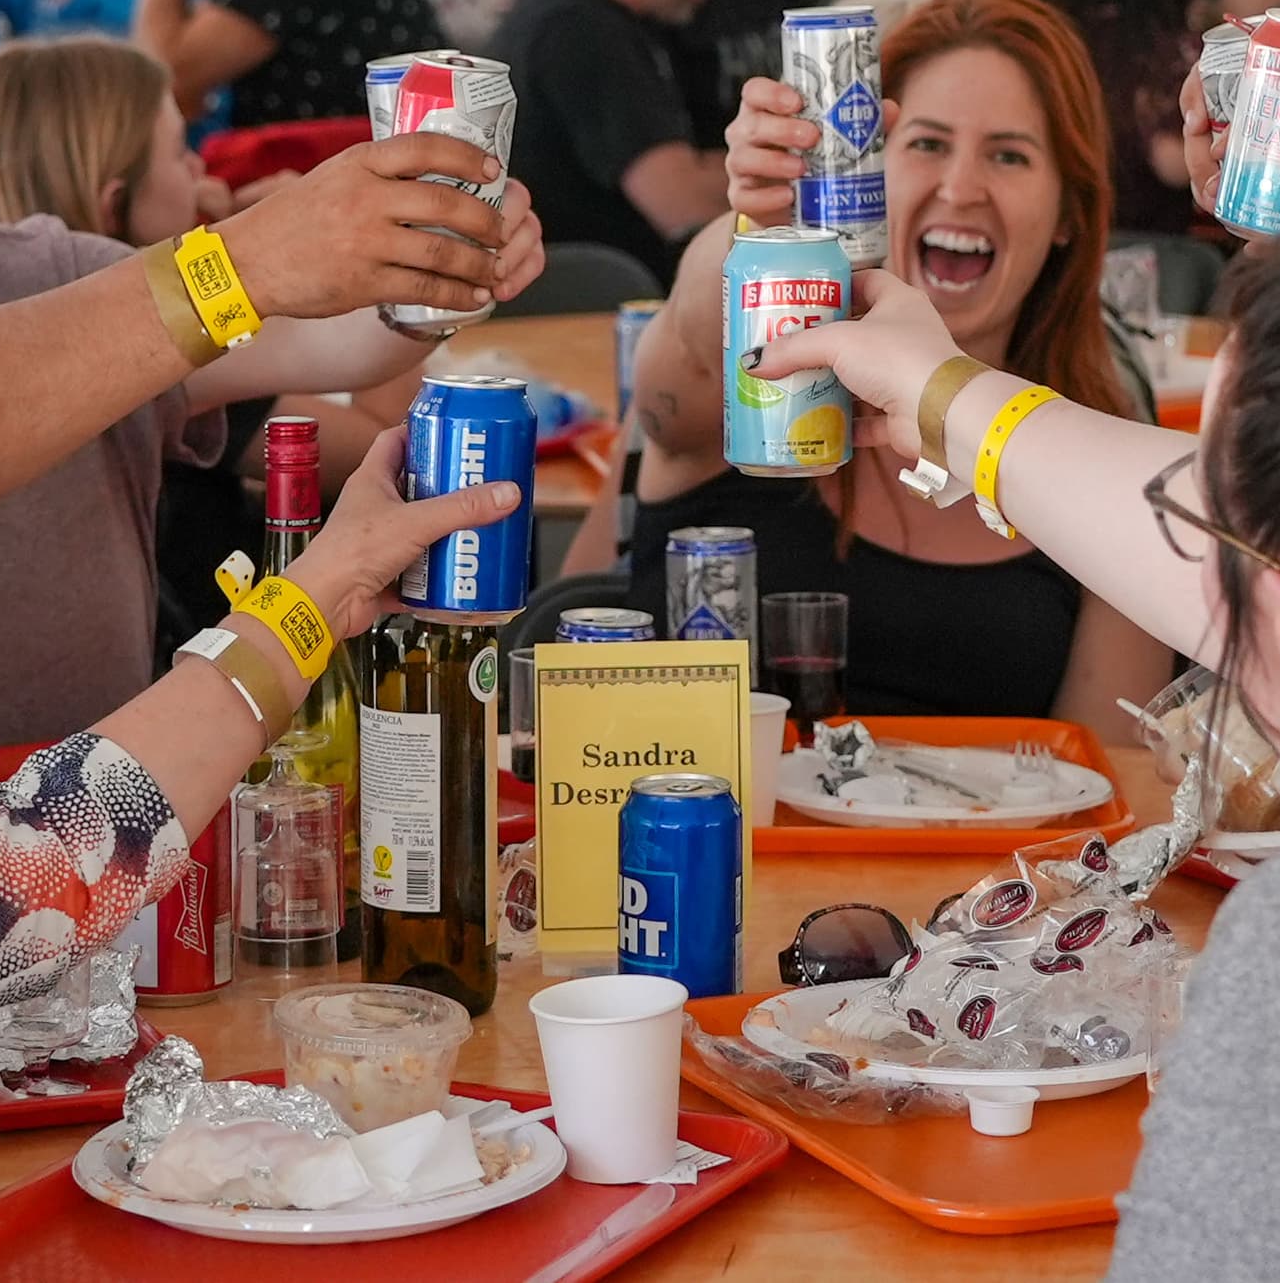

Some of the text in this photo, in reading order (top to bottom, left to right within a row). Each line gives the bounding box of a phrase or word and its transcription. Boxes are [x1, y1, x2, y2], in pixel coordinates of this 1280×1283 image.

[747, 283, 835, 303] SMIRNOFF
[452, 426, 487, 602] BUD GHT.
[582, 741, 698, 769] Sandra
[550, 781, 633, 806] Desr
